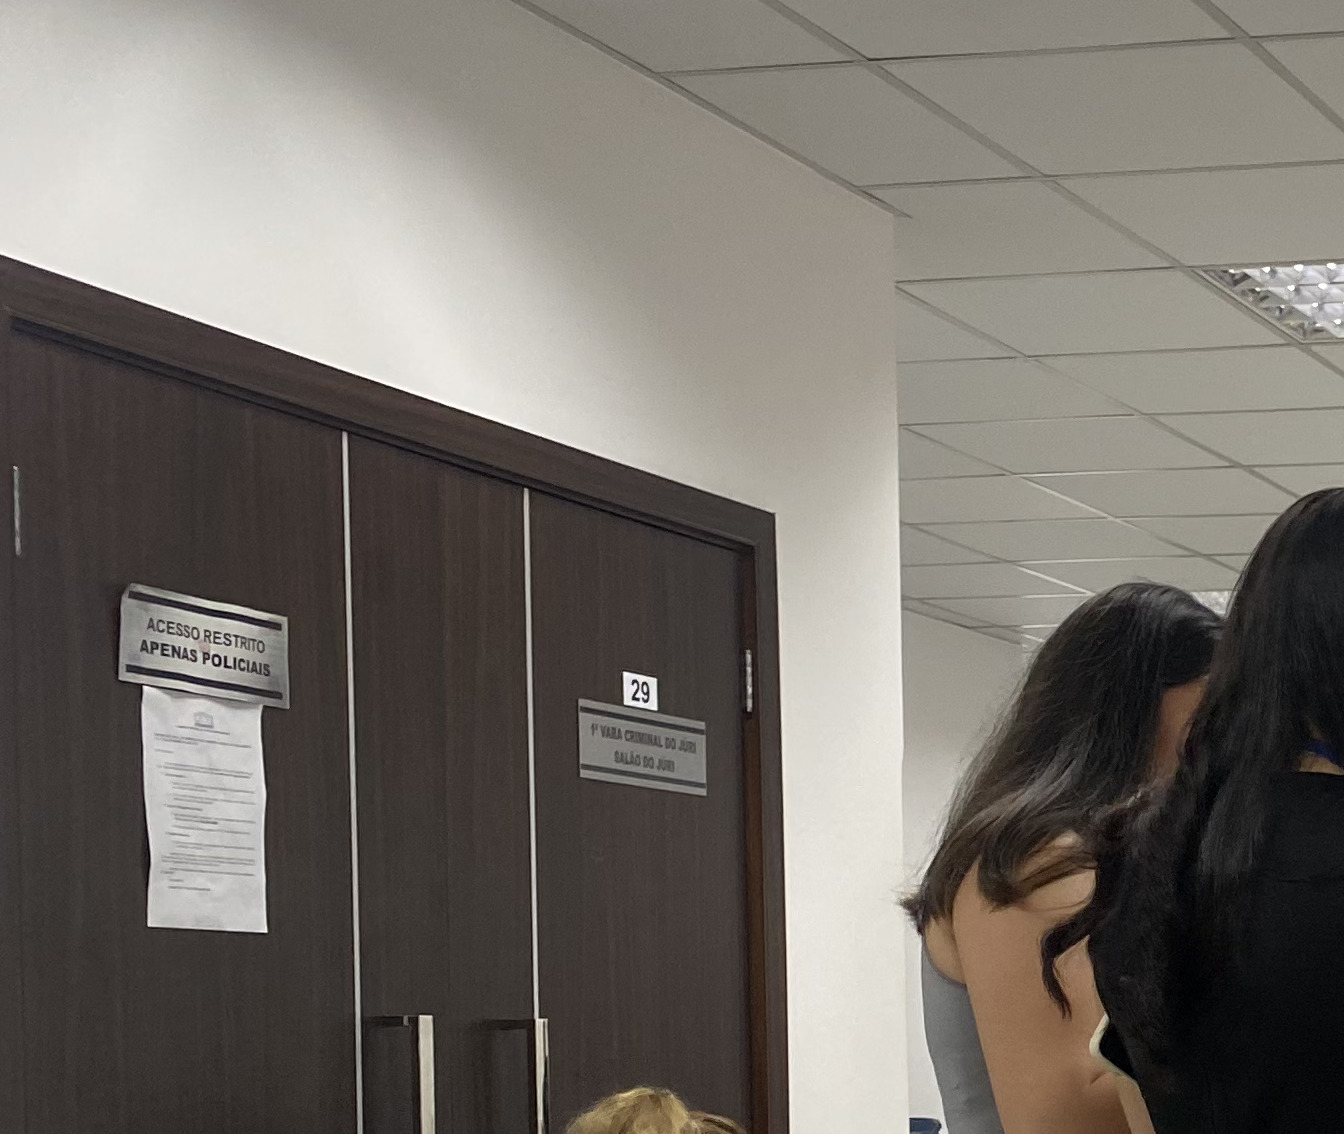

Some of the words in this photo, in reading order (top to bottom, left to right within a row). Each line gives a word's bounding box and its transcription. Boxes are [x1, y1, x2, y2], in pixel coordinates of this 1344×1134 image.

[146, 617, 200, 641] ACESSO
[203, 629, 266, 654] RESTRITO
[139, 639, 198, 663] APENAS
[202, 651, 271, 677] POLICIAIS
[631, 679, 650, 704] 29
[624, 729, 664, 748] CRIMINAL
[664, 737, 676, 750] DO
[614, 750, 641, 767] SALÃO
[643, 755, 655, 769] DO
